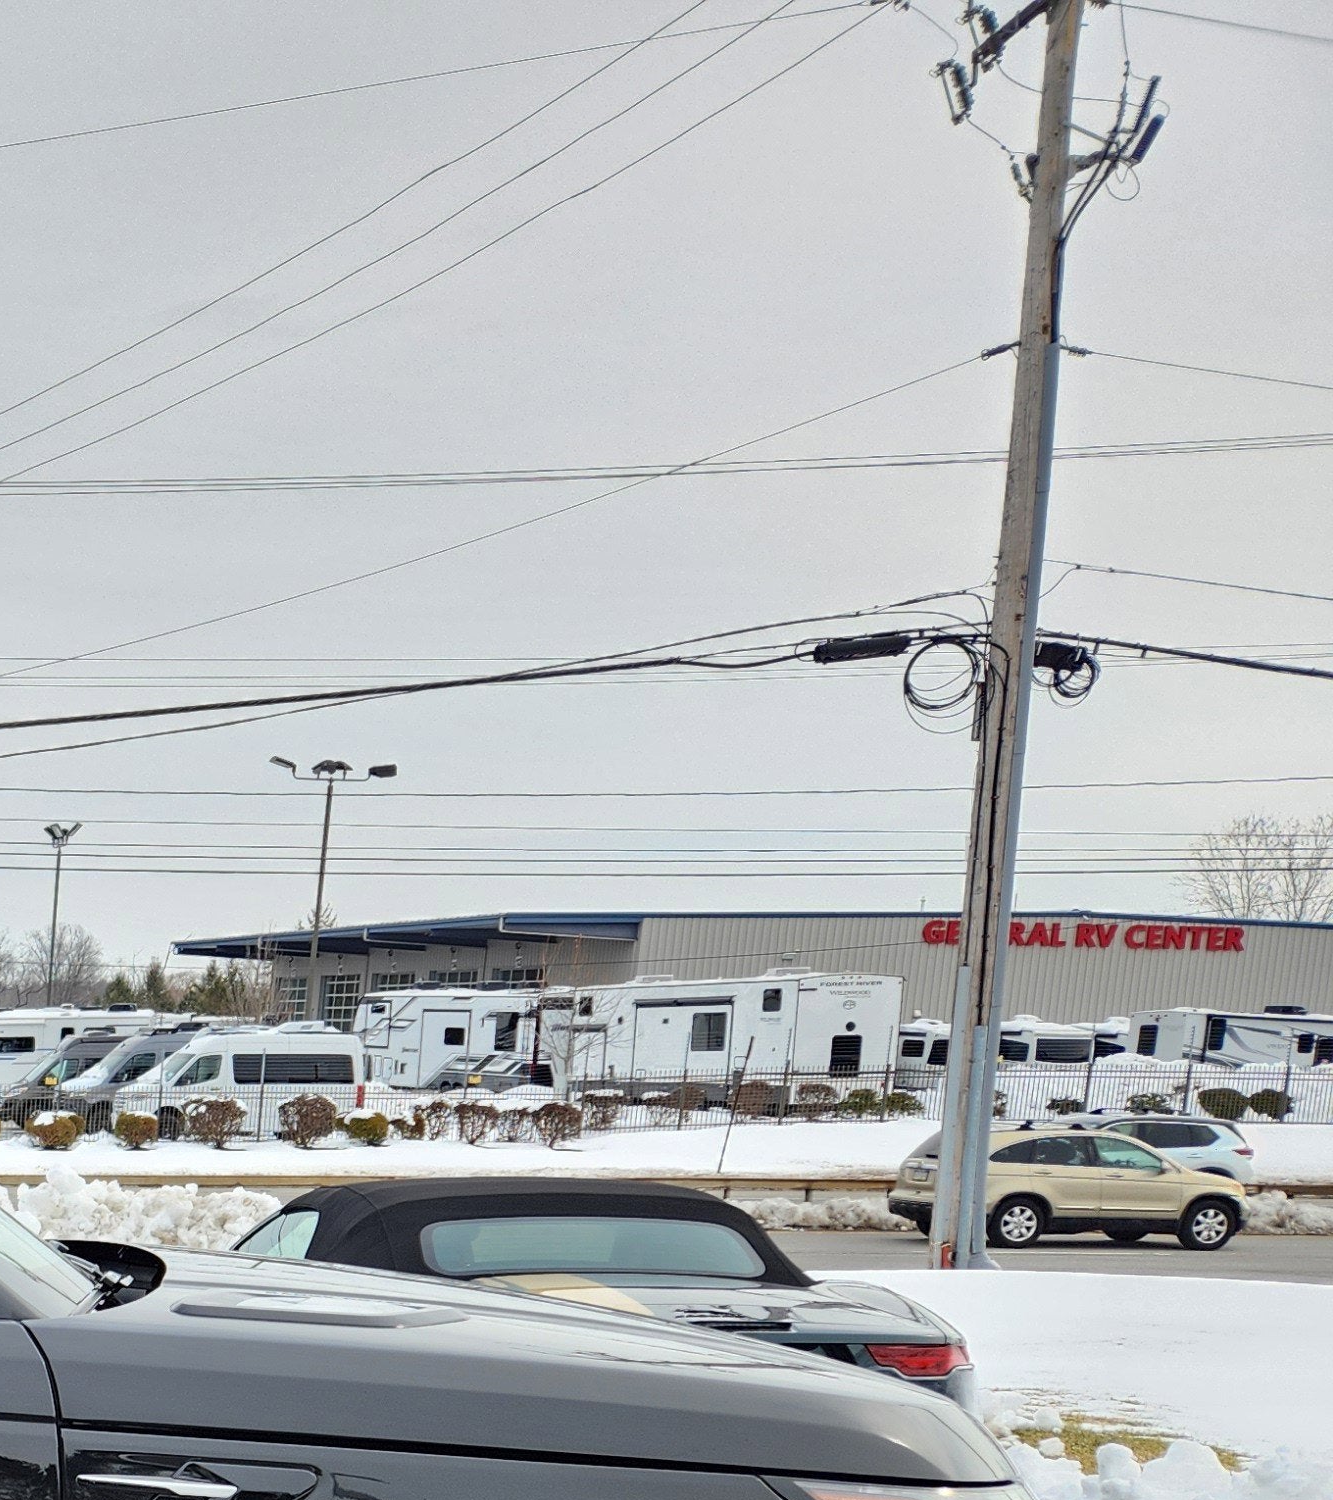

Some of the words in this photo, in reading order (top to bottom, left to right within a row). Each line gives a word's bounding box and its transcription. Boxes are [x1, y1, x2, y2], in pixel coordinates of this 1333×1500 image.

[922, 920, 1066, 948] GERAL
[1075, 922, 1118, 949] RV
[1124, 924, 1245, 953] CENTER
